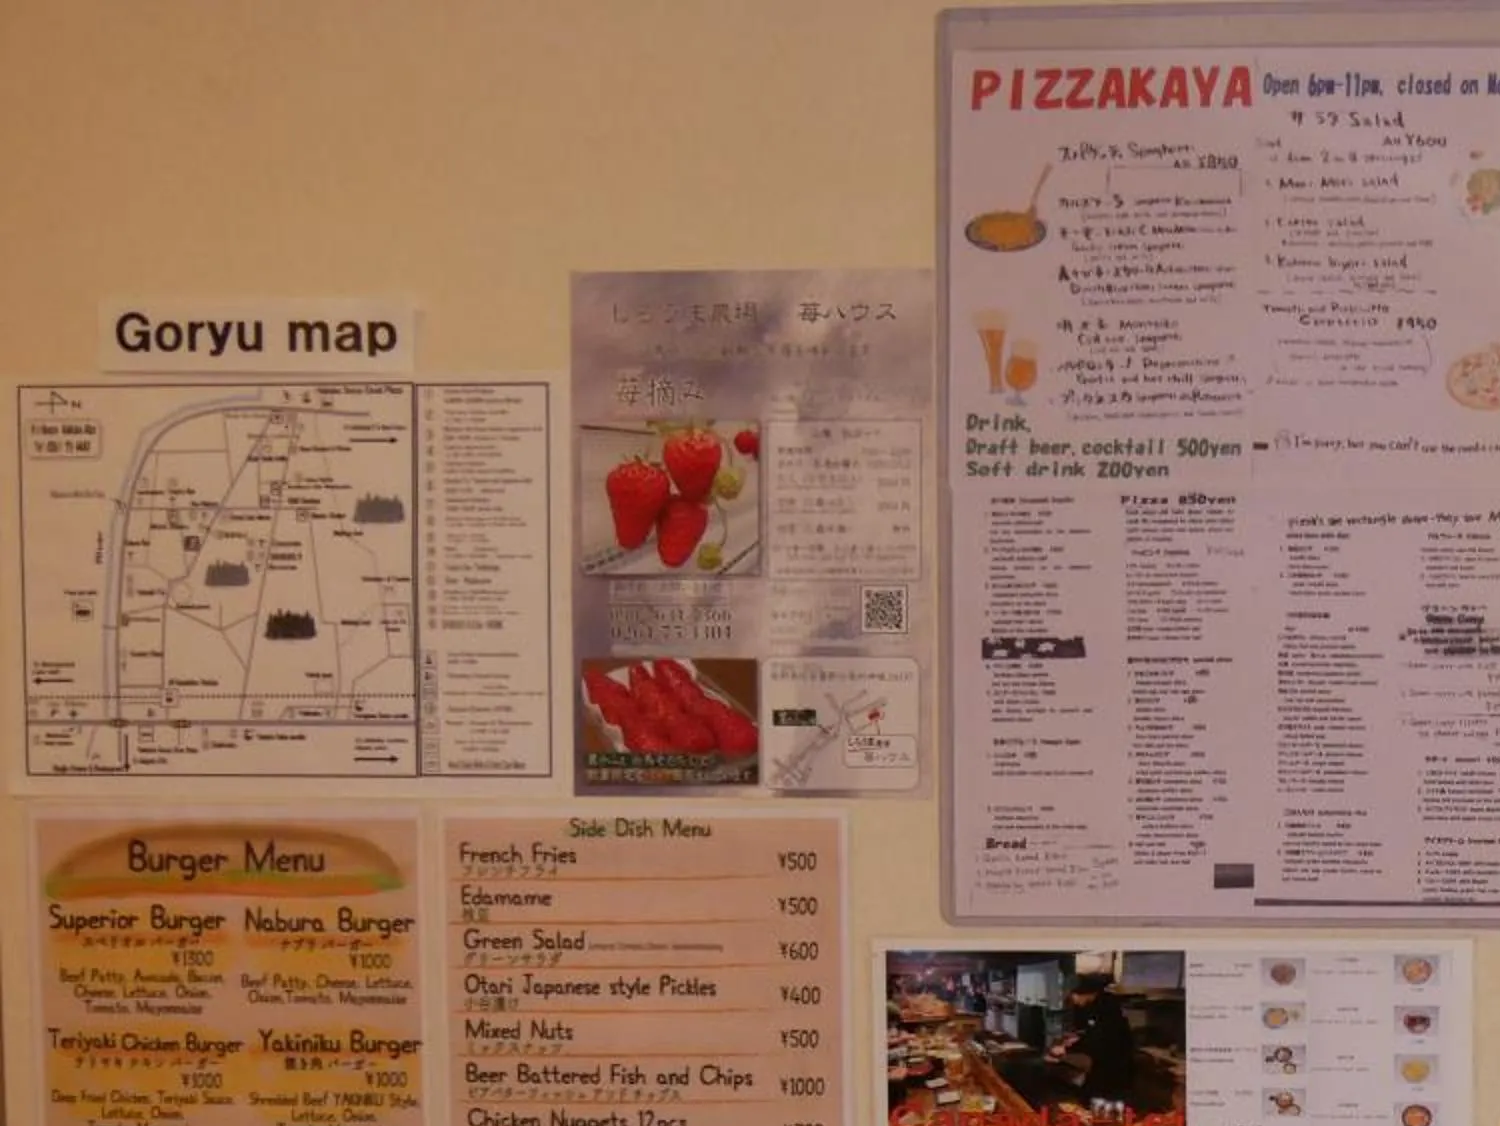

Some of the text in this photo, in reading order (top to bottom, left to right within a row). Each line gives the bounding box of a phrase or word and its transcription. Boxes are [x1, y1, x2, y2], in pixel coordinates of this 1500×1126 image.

[970, 65, 1252, 110] PIZZAKAYA
[1263, 73, 1300, 96] Open
[1398, 75, 1452, 95] closed
[1460, 78, 1479, 95] on
[799, 302, 898, 322] 苺ハウス
[115, 312, 398, 357] Goryu map
[966, 438, 1242, 458] Draft cocktail 500yen
[966, 461, 1170, 480] Soft drink 200yen
[569, 819, 712, 838] Side Dish Menu
[128, 839, 325, 880] Burger Menu
[460, 842, 817, 871] French Fries ¥500
[984, 838, 1027, 851] Bread
[460, 885, 818, 916] Edamame ¥500
[50, 904, 226, 937] Superior Burger
[245, 906, 416, 940] Nabura Burger
[463, 929, 819, 961] Green Salad ¥600
[464, 974, 821, 1005] Otari Japanese style Pickles ¥400
[48, 1027, 245, 1059] Teriyaki Chicken Burger
[258, 1029, 423, 1059] Yakiniku Burger
[465, 1020, 819, 1049] Mixed Nuts ¥500
[465, 1063, 825, 1096] Beer Battered Fish and Chips ¥1000
